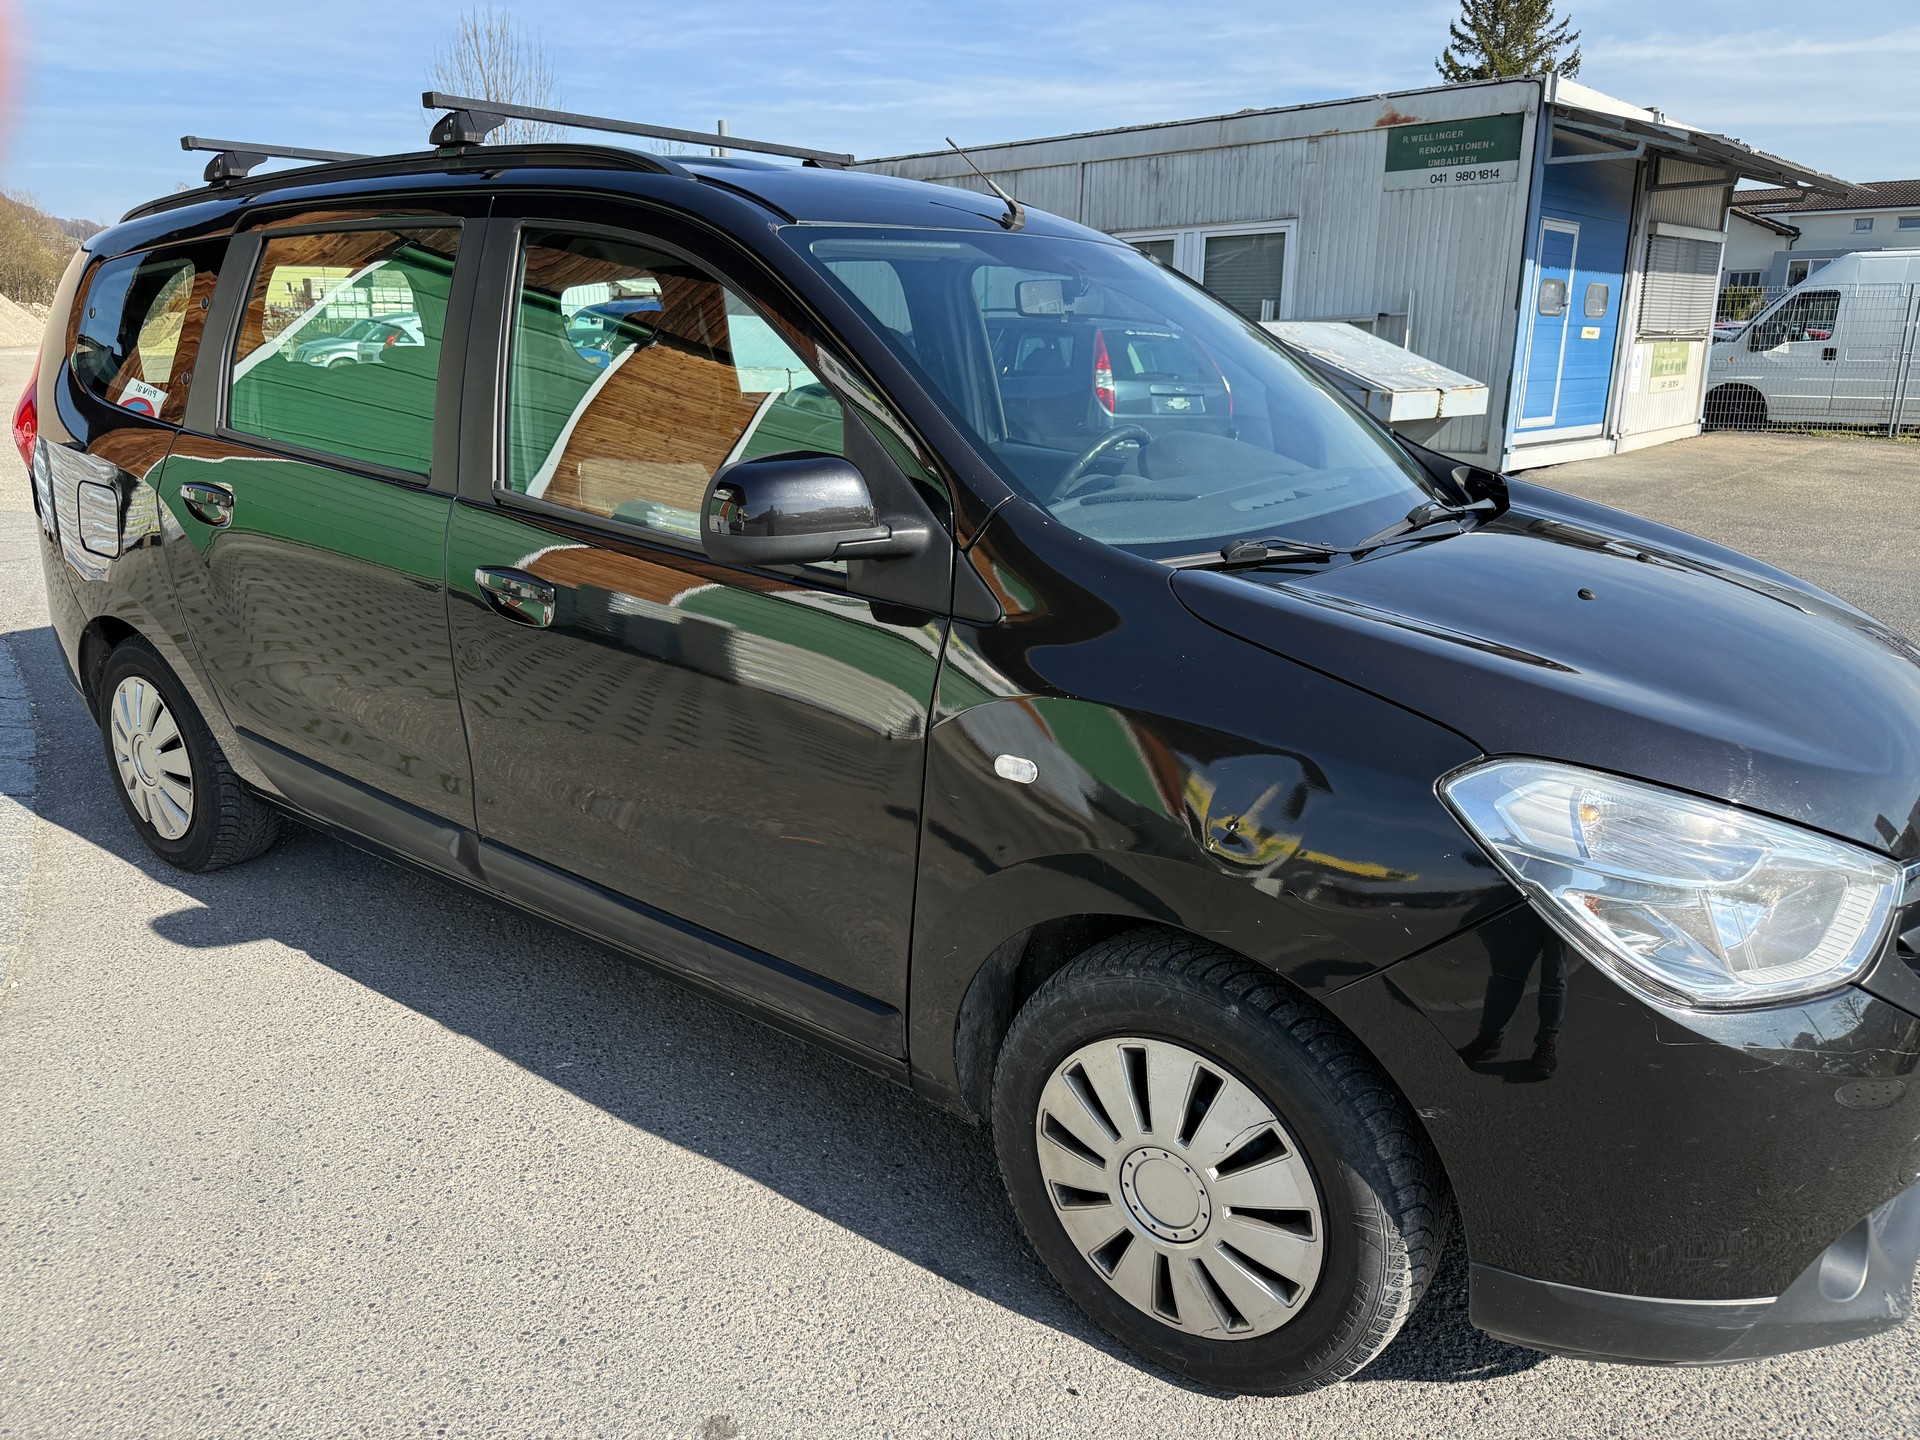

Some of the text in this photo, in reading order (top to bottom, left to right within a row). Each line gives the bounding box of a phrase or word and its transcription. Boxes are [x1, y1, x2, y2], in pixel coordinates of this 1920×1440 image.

[1411, 131, 1464, 143] WELLINGER
[1419, 141, 1489, 155] RENOVATIONEN
[1428, 156, 1477, 167] UMBAUTEN
[1430, 173, 1447, 184] 041
